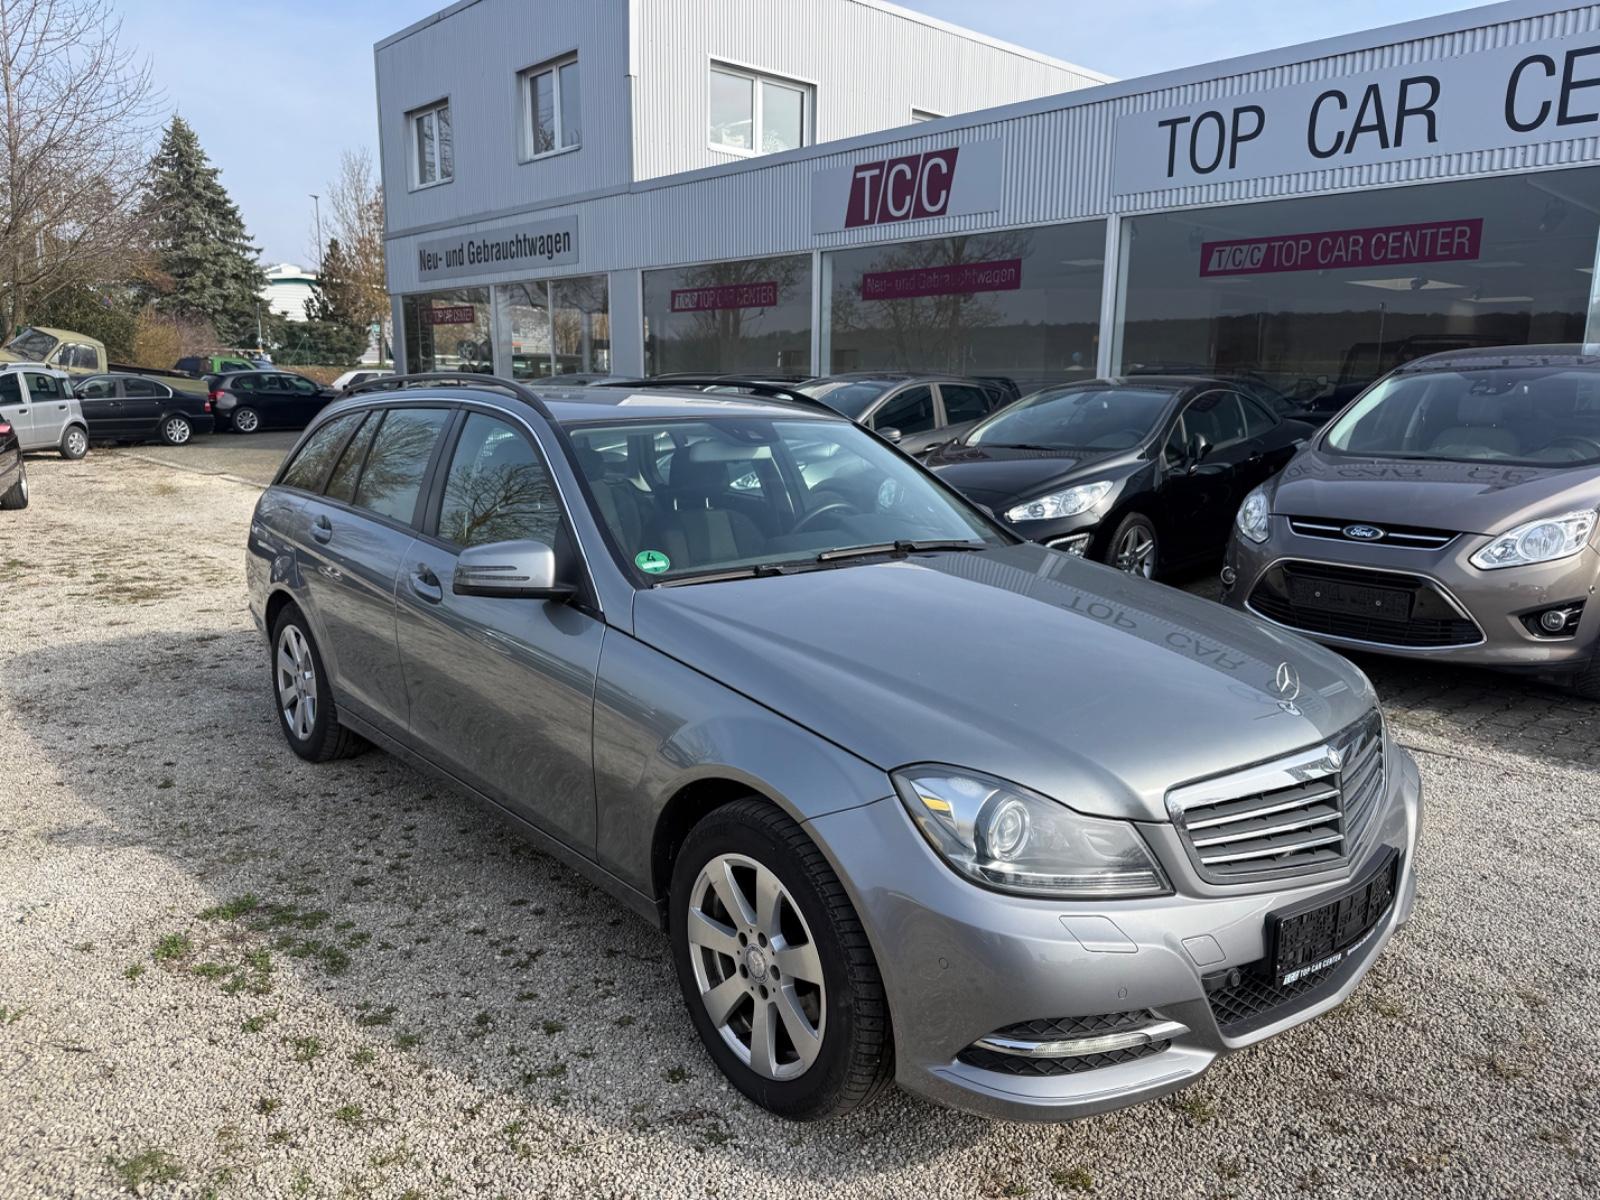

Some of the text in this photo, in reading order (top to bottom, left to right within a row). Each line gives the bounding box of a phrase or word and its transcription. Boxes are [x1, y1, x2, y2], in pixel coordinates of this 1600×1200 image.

[1158, 45, 1600, 178] TOP CAR CE
[855, 156, 948, 221] TCC
[419, 231, 571, 272] Neu- und Gebrauchtwagen
[1270, 240, 1312, 267] TOP
[1318, 235, 1364, 264] CAR
[1370, 226, 1471, 260] CENTER
[918, 267, 1016, 290] Gebrachtwagen
[1350, 527, 1374, 537] Ford
[646, 552, 656, 562] 4
